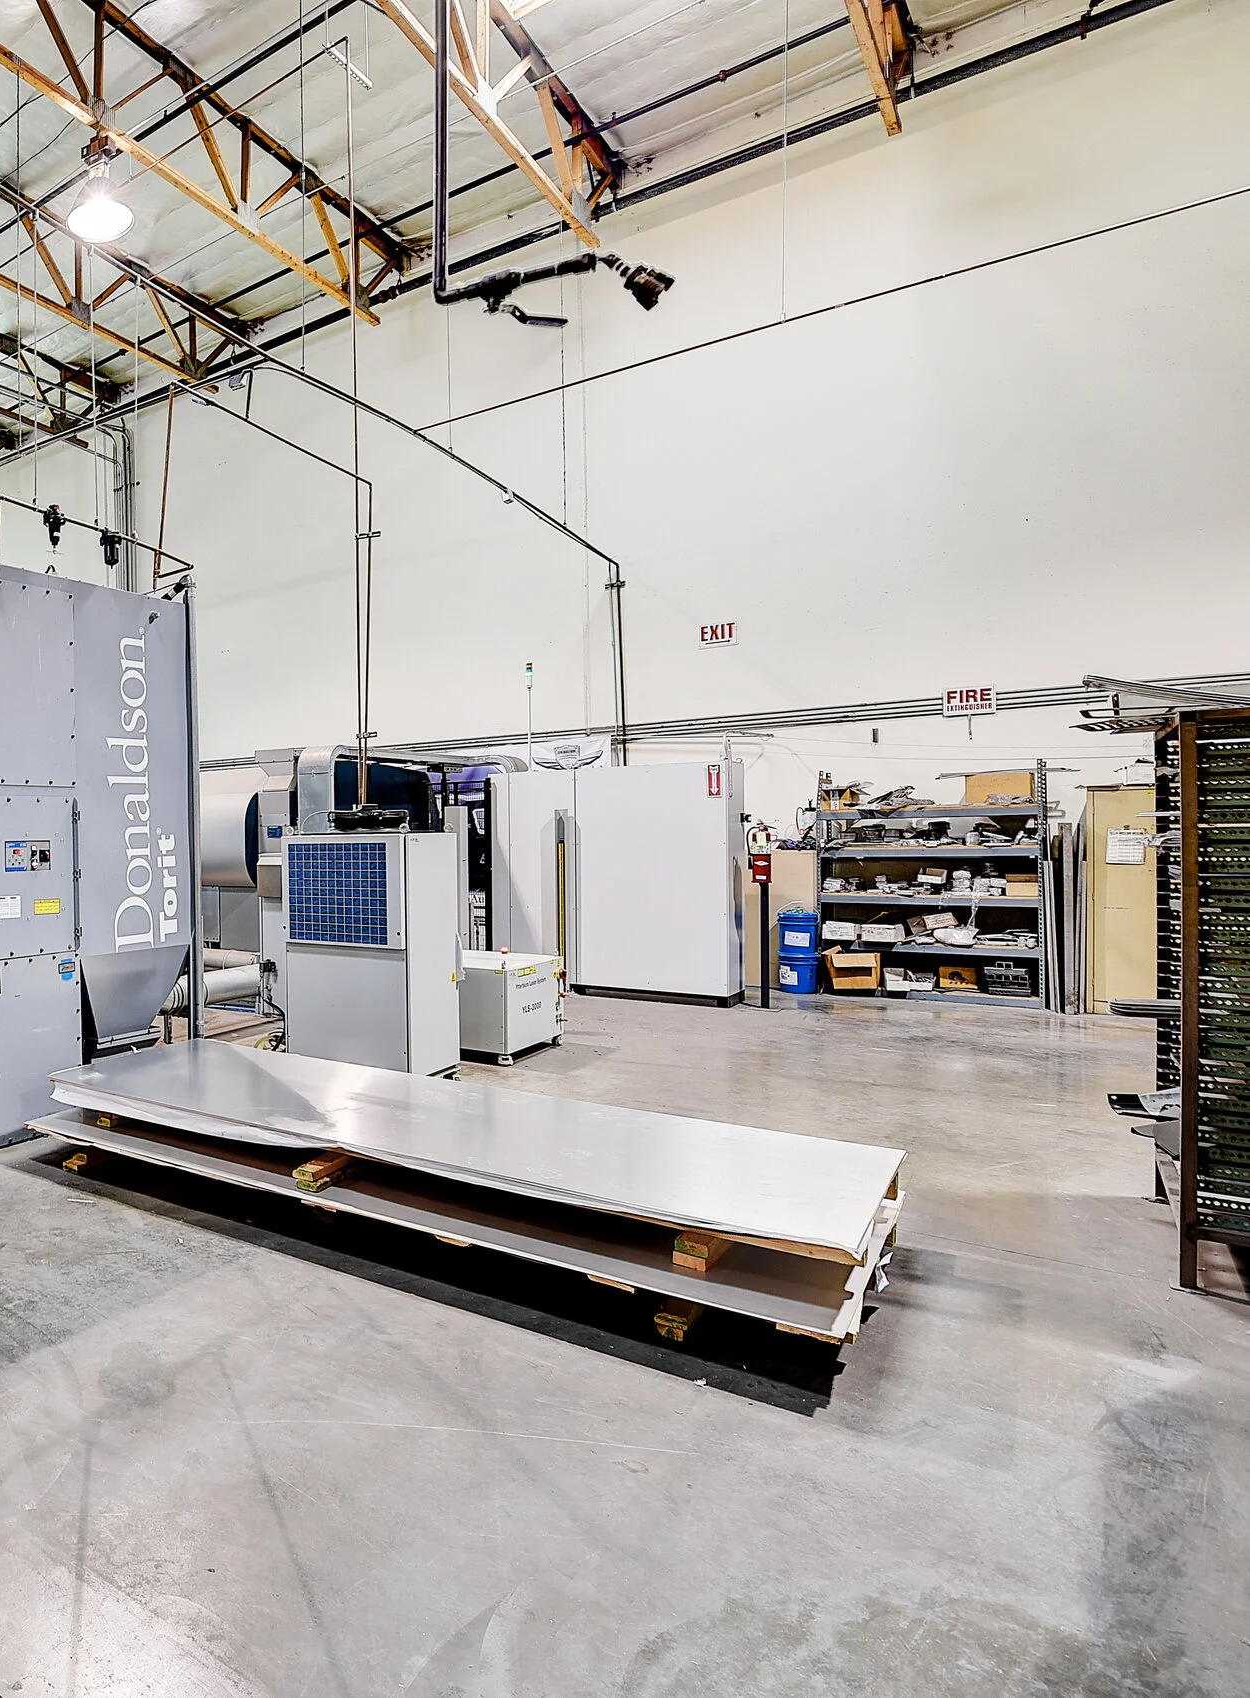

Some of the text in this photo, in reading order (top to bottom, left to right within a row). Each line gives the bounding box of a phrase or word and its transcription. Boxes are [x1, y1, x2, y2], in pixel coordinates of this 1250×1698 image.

[700, 622, 736, 642] EXIT
[946, 687, 993, 705] FIRE
[946, 702, 993, 712] EXTINGUISHER
[105, 633, 155, 953] Donaldson
[156, 833, 179, 943] Torit
